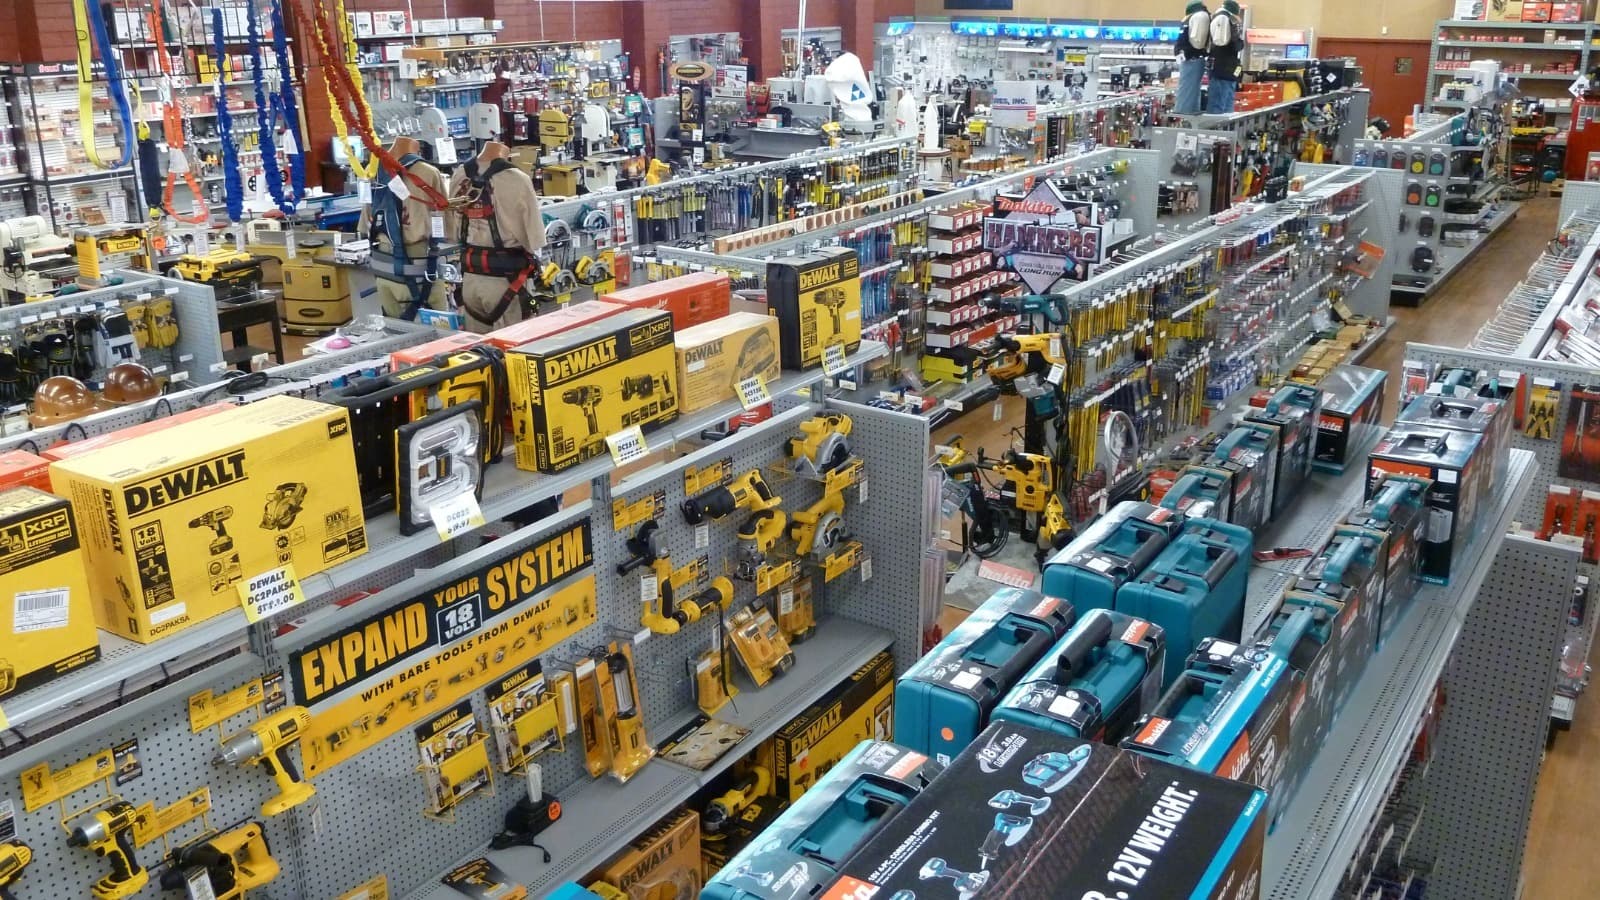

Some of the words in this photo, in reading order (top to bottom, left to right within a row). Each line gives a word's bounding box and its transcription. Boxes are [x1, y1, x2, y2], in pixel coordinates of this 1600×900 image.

[988, 222, 1096, 259] HAMMERS
[800, 264, 840, 287] DEWALT
[651, 319, 670, 334] XRP
[545, 337, 617, 383] DEWALT
[684, 340, 724, 364] DEWALT
[527, 359, 541, 406] DEWALT
[124, 453, 247, 516] DEWALT
[26, 514, 65, 535] XRP
[101, 488, 124, 555] DEWALT
[138, 526, 156, 539] 18
[139, 537, 156, 546] Volt
[247, 580, 296, 606] DC2PAKSA
[249, 570, 286, 592] DEWALT
[150, 615, 190, 636] DC2PAKSA
[302, 604, 428, 700] EXPAND
[433, 576, 480, 608] YOUR
[486, 526, 585, 611] SYSTEM
[444, 603, 474, 626] 18
[444, 619, 478, 641] VOLT
[361, 678, 396, 703] WITH
[399, 663, 432, 684] BARE
[435, 641, 474, 666] TOOLS
[477, 621, 510, 643] FROM
[512, 599, 553, 628] DEWALT
[502, 667, 530, 690] DEWALT
[432, 708, 460, 732] DEWALT
[791, 702, 842, 757] DEWALT
[976, 742, 1004, 764] 18V
[1128, 782, 1199, 853] WEIGHT.
[890, 834, 917, 860] CORDLESS
[913, 818, 933, 836] COMBO
[929, 809, 941, 820] KIT
[620, 841, 674, 886] DEWALT
[1107, 846, 1153, 886] 12V
